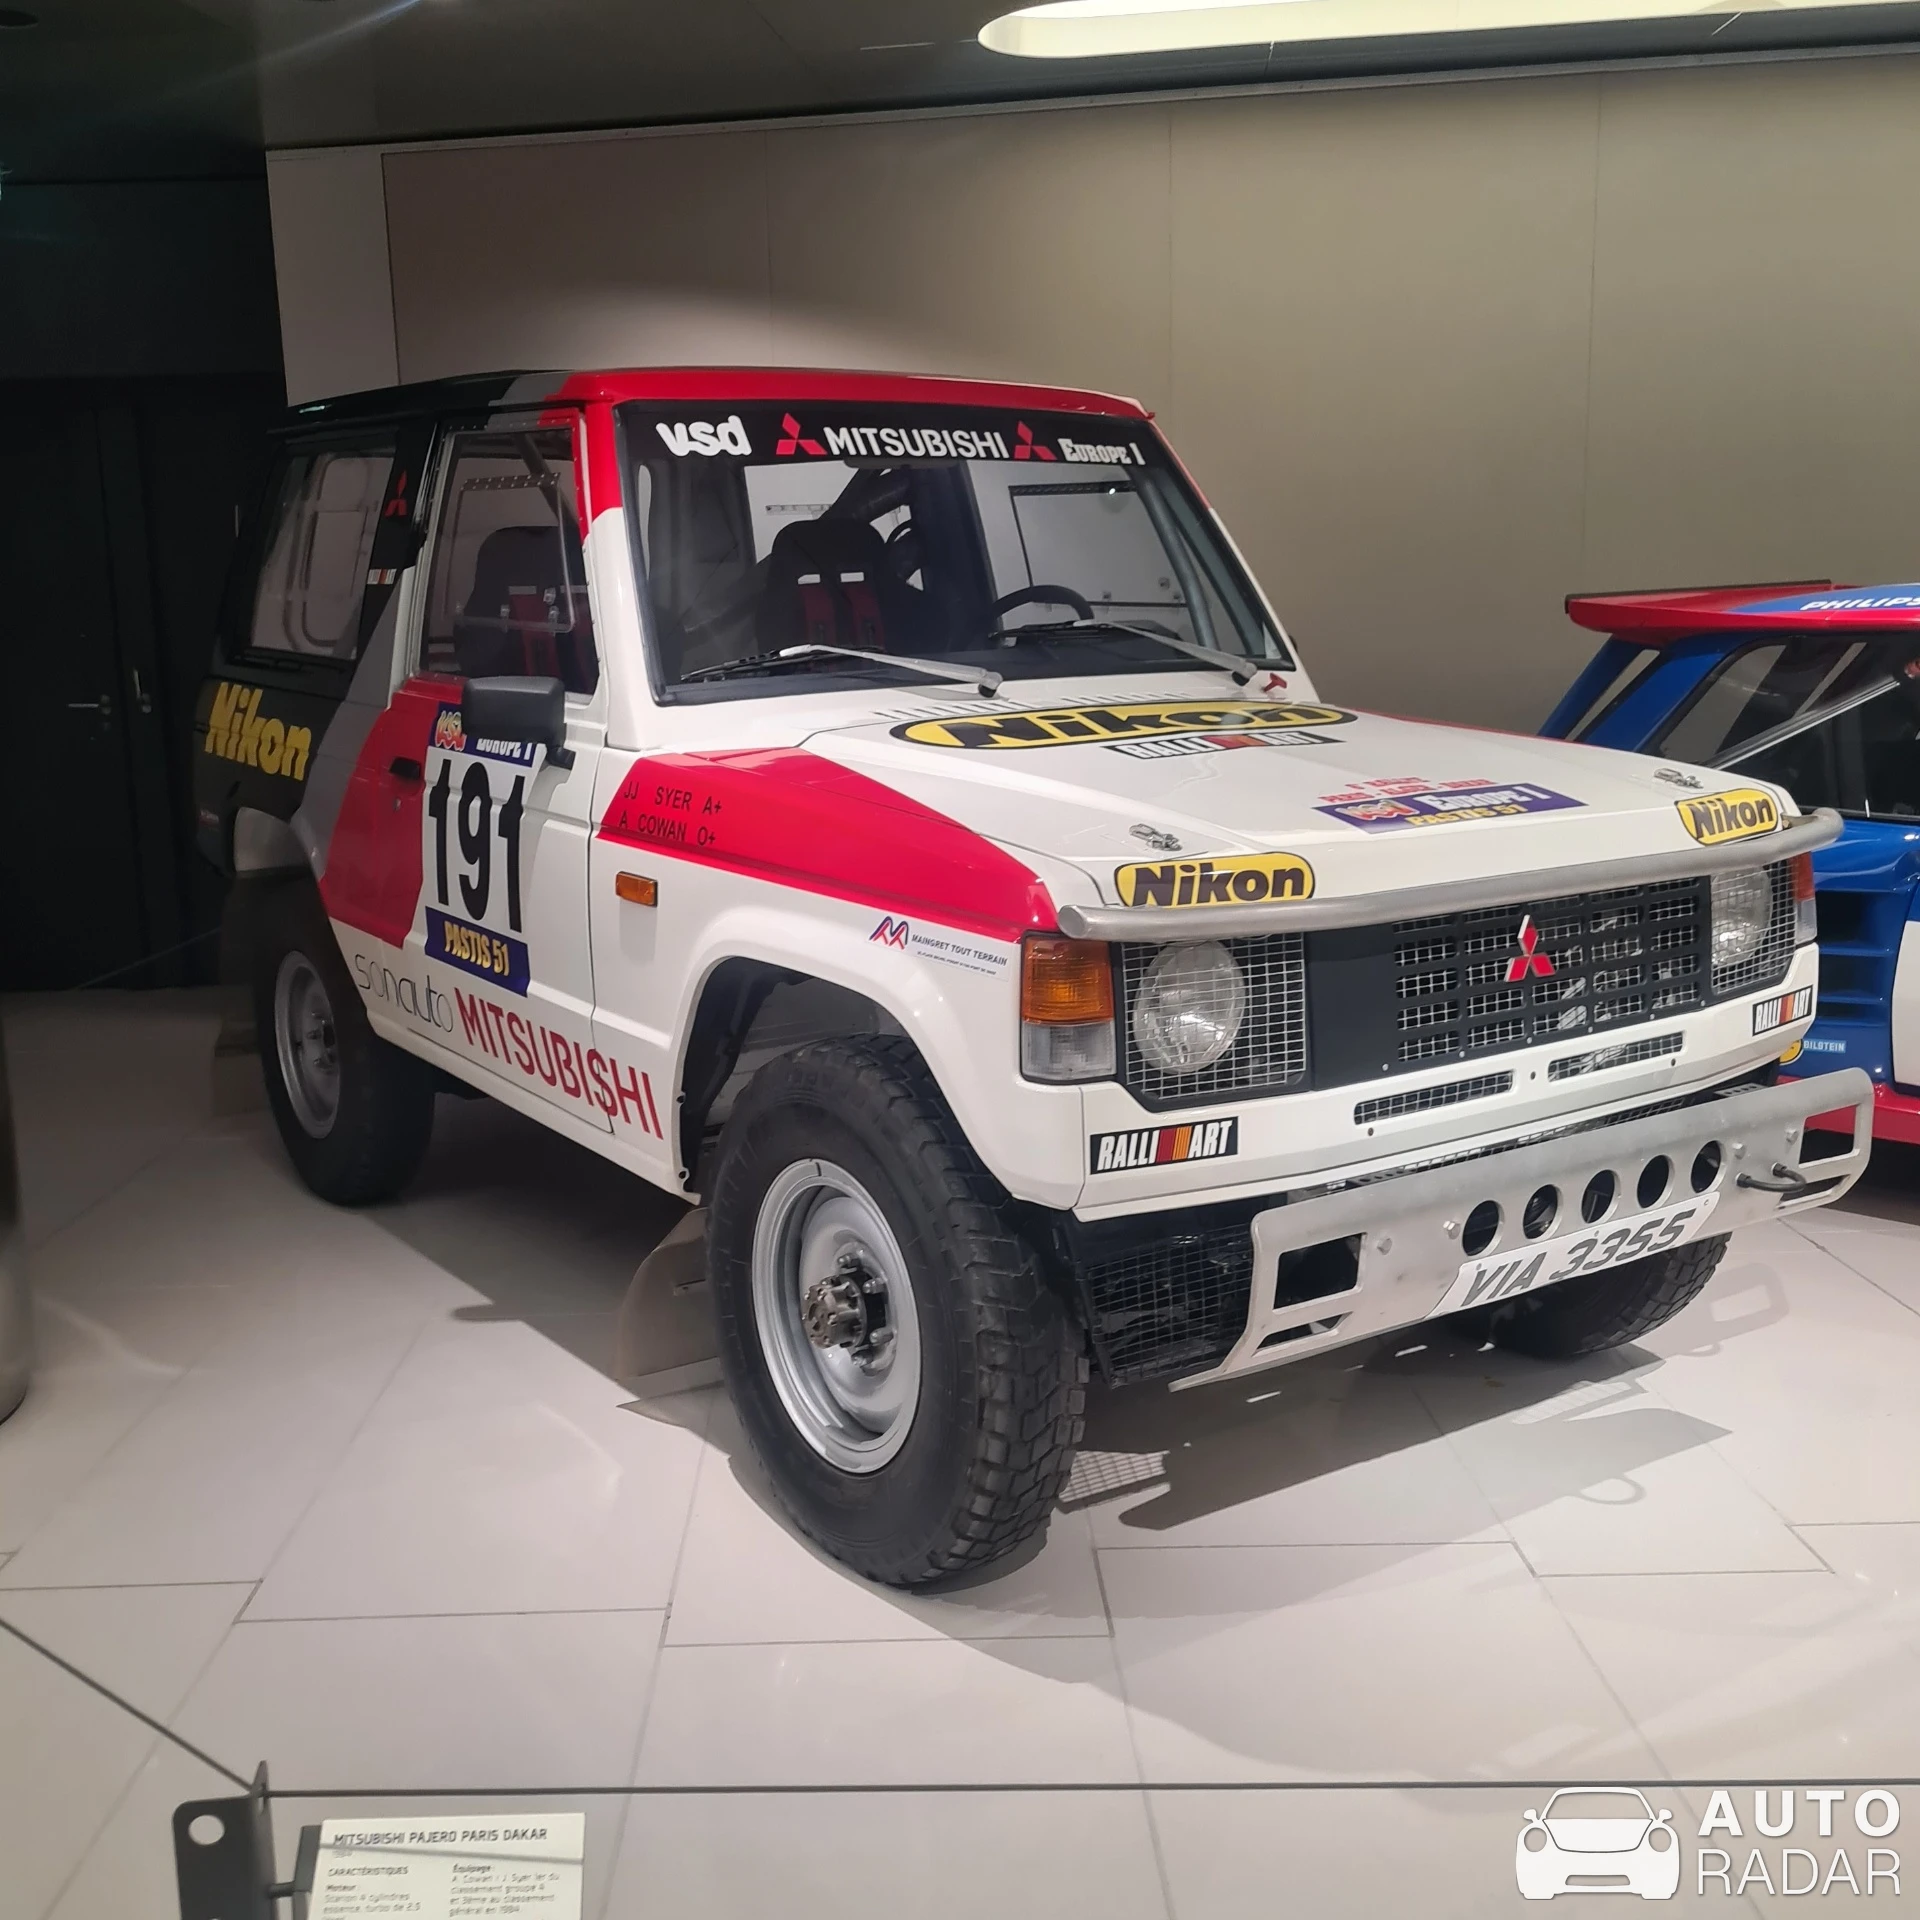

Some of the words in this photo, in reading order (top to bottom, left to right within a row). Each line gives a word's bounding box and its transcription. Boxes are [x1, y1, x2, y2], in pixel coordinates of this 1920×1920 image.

[656, 415, 752, 457] vsd
[823, 427, 1010, 459] MITSUBISHI
[205, 682, 312, 781] Nikon
[940, 705, 1322, 748] Nikon
[624, 780, 638, 800] JJ
[655, 787, 691, 811] SYER
[703, 795, 722, 815] A+
[1405, 808, 1497, 826] PASTIS
[1492, 804, 1528, 813] 51
[1693, 793, 1774, 841] Nikon
[428, 759, 523, 933] 191
[619, 811, 627, 827] A
[638, 814, 686, 842] COWAN
[1134, 866, 1306, 907] Nikon
[444, 920, 490, 969] PASTIS
[493, 942, 509, 976] 51
[951, 944, 972, 956] TOUT
[973, 950, 1008, 966] TERRAIN
[354, 954, 454, 1033] sonauto
[454, 987, 663, 1139] MITSUBISHI
[1803, 1040, 1846, 1051] BILSTEIN
[1463, 1252, 1546, 1306] VIA
[1550, 1208, 1697, 1280] 3355
[333, 1832, 405, 1847] MITSUBISHI
[409, 1831, 457, 1844] PAJERO
[460, 1829, 499, 1842] PARIS
[503, 1828, 547, 1841] DAKAR
